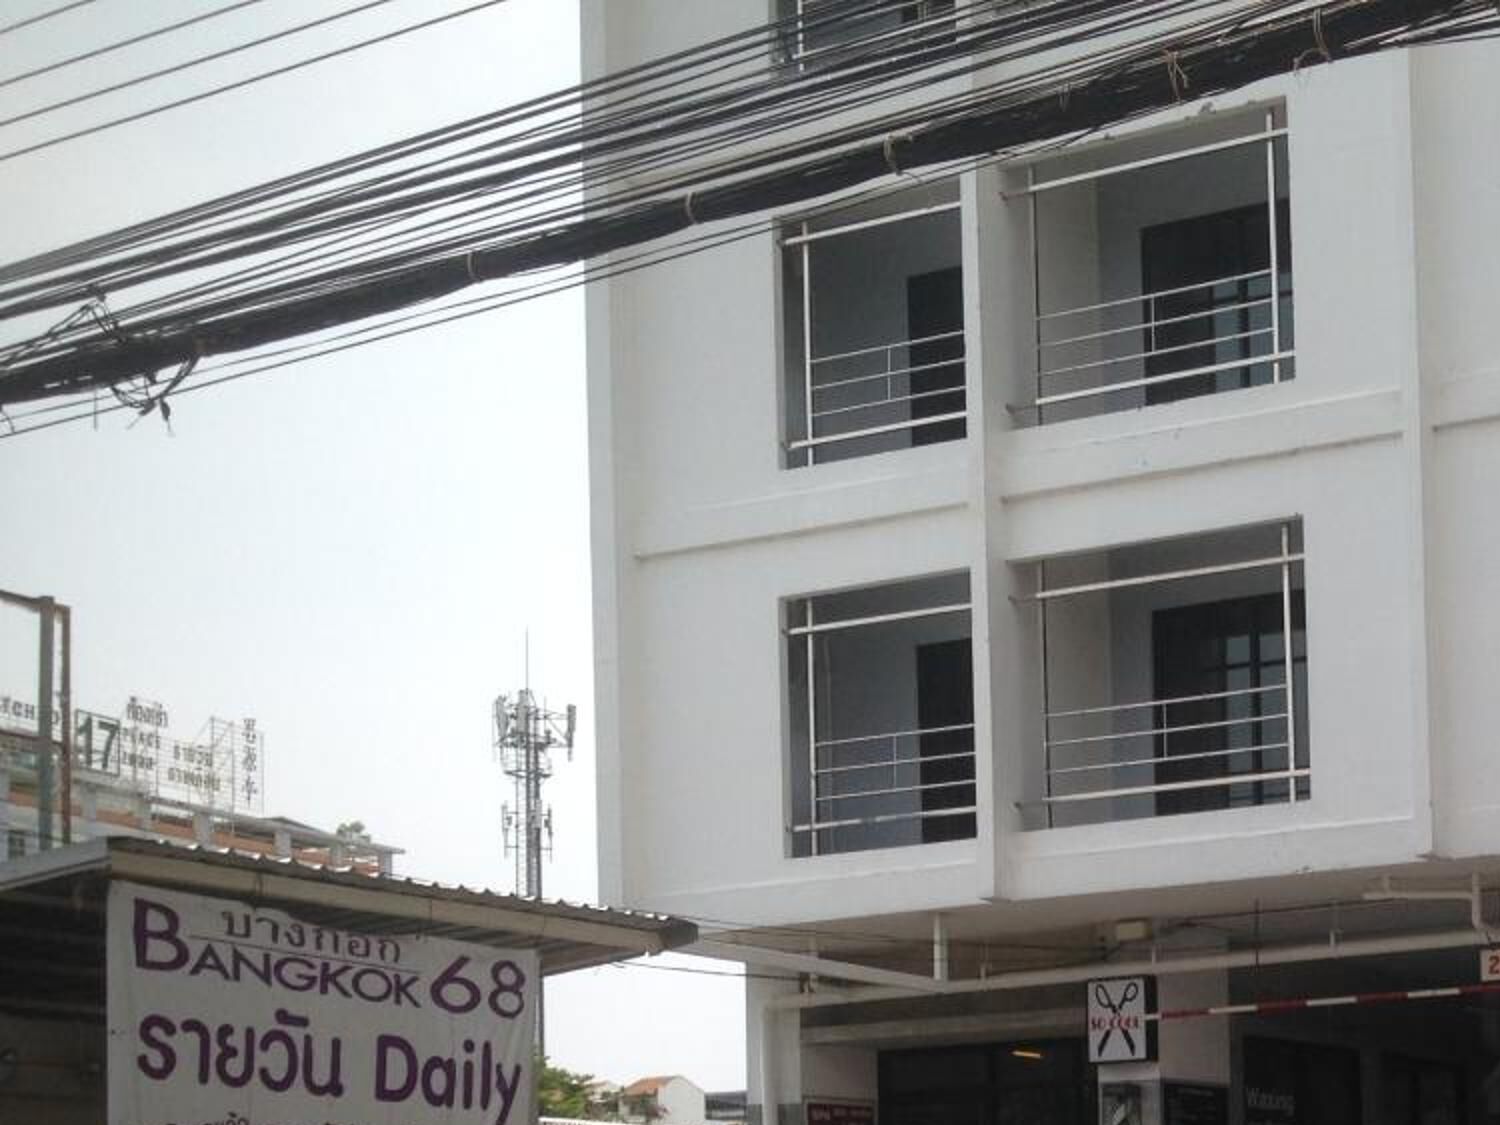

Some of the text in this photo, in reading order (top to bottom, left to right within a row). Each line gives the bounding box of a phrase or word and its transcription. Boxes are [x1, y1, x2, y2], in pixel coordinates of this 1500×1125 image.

[78, 714, 119, 769] 17
[429, 955, 526, 1019] 68
[136, 1007, 345, 1098] รายวัน
